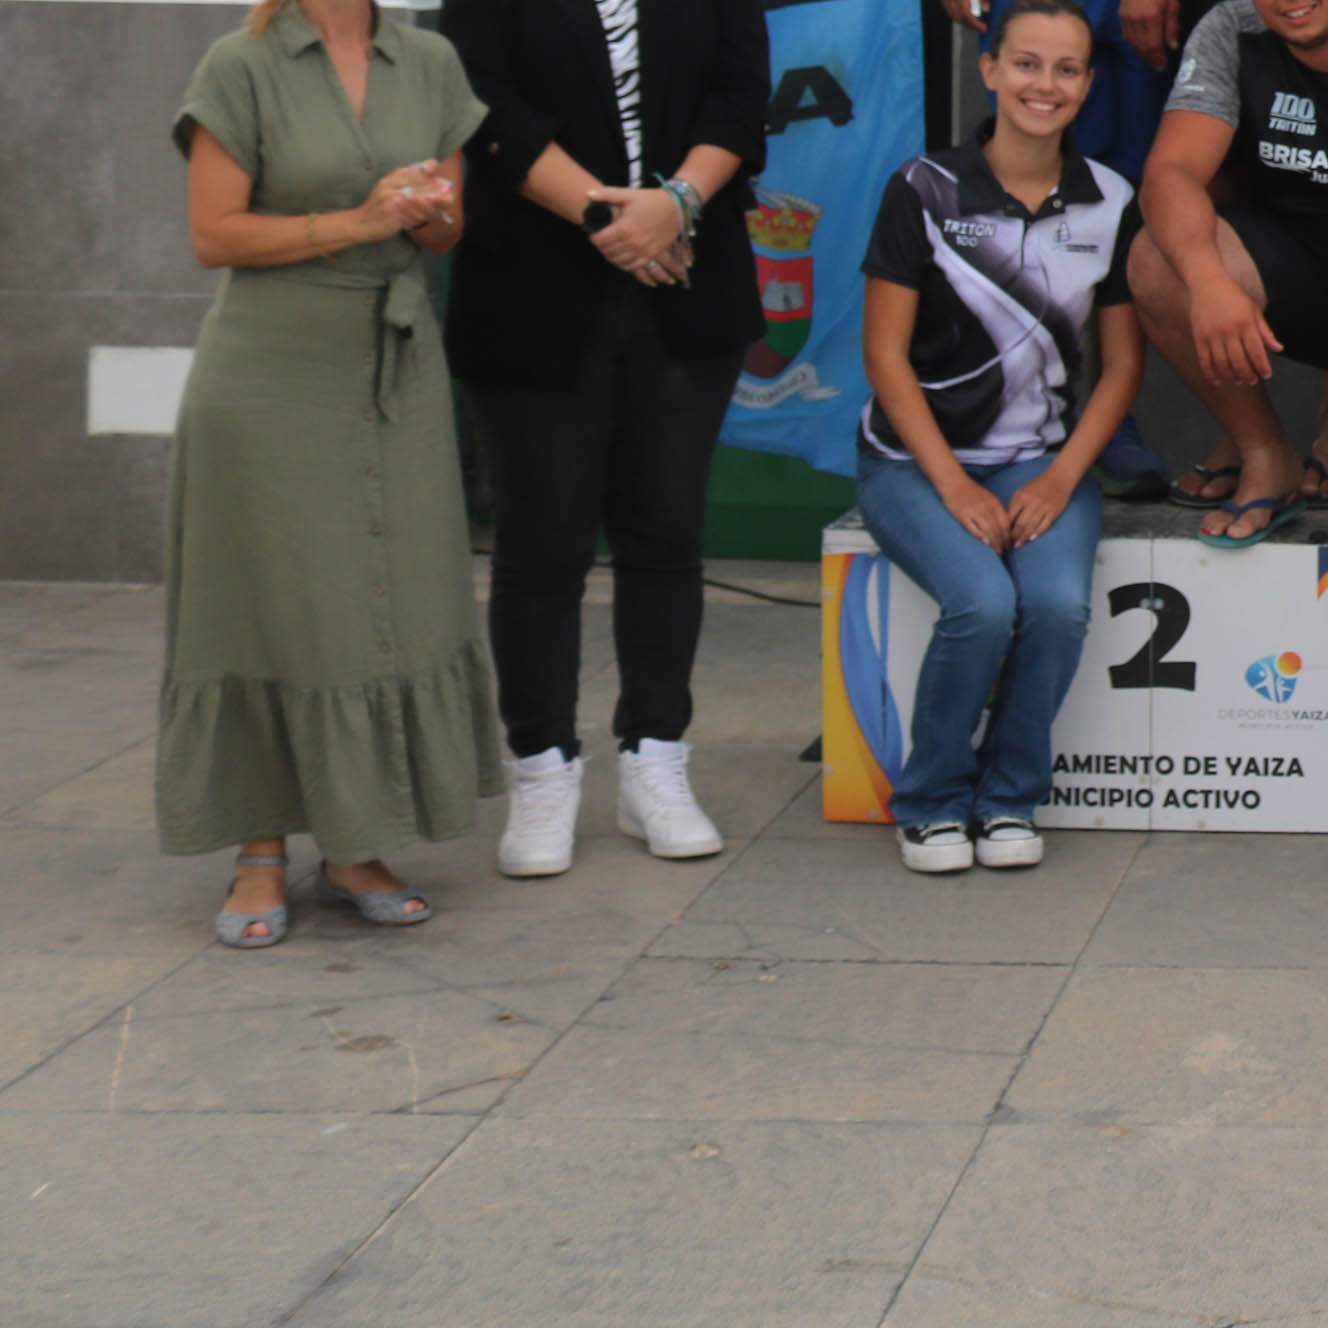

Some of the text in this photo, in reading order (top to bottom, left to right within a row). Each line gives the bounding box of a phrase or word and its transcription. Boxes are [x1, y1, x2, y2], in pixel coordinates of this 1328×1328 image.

[1271, 90, 1316, 121] 100
[943, 218, 993, 236] TRITON
[1108, 582, 1197, 691] 2
[1053, 754, 1304, 777] AMIENTO DE YAIZA
[1040, 787, 1261, 809] NICIPIO ACTIVO
